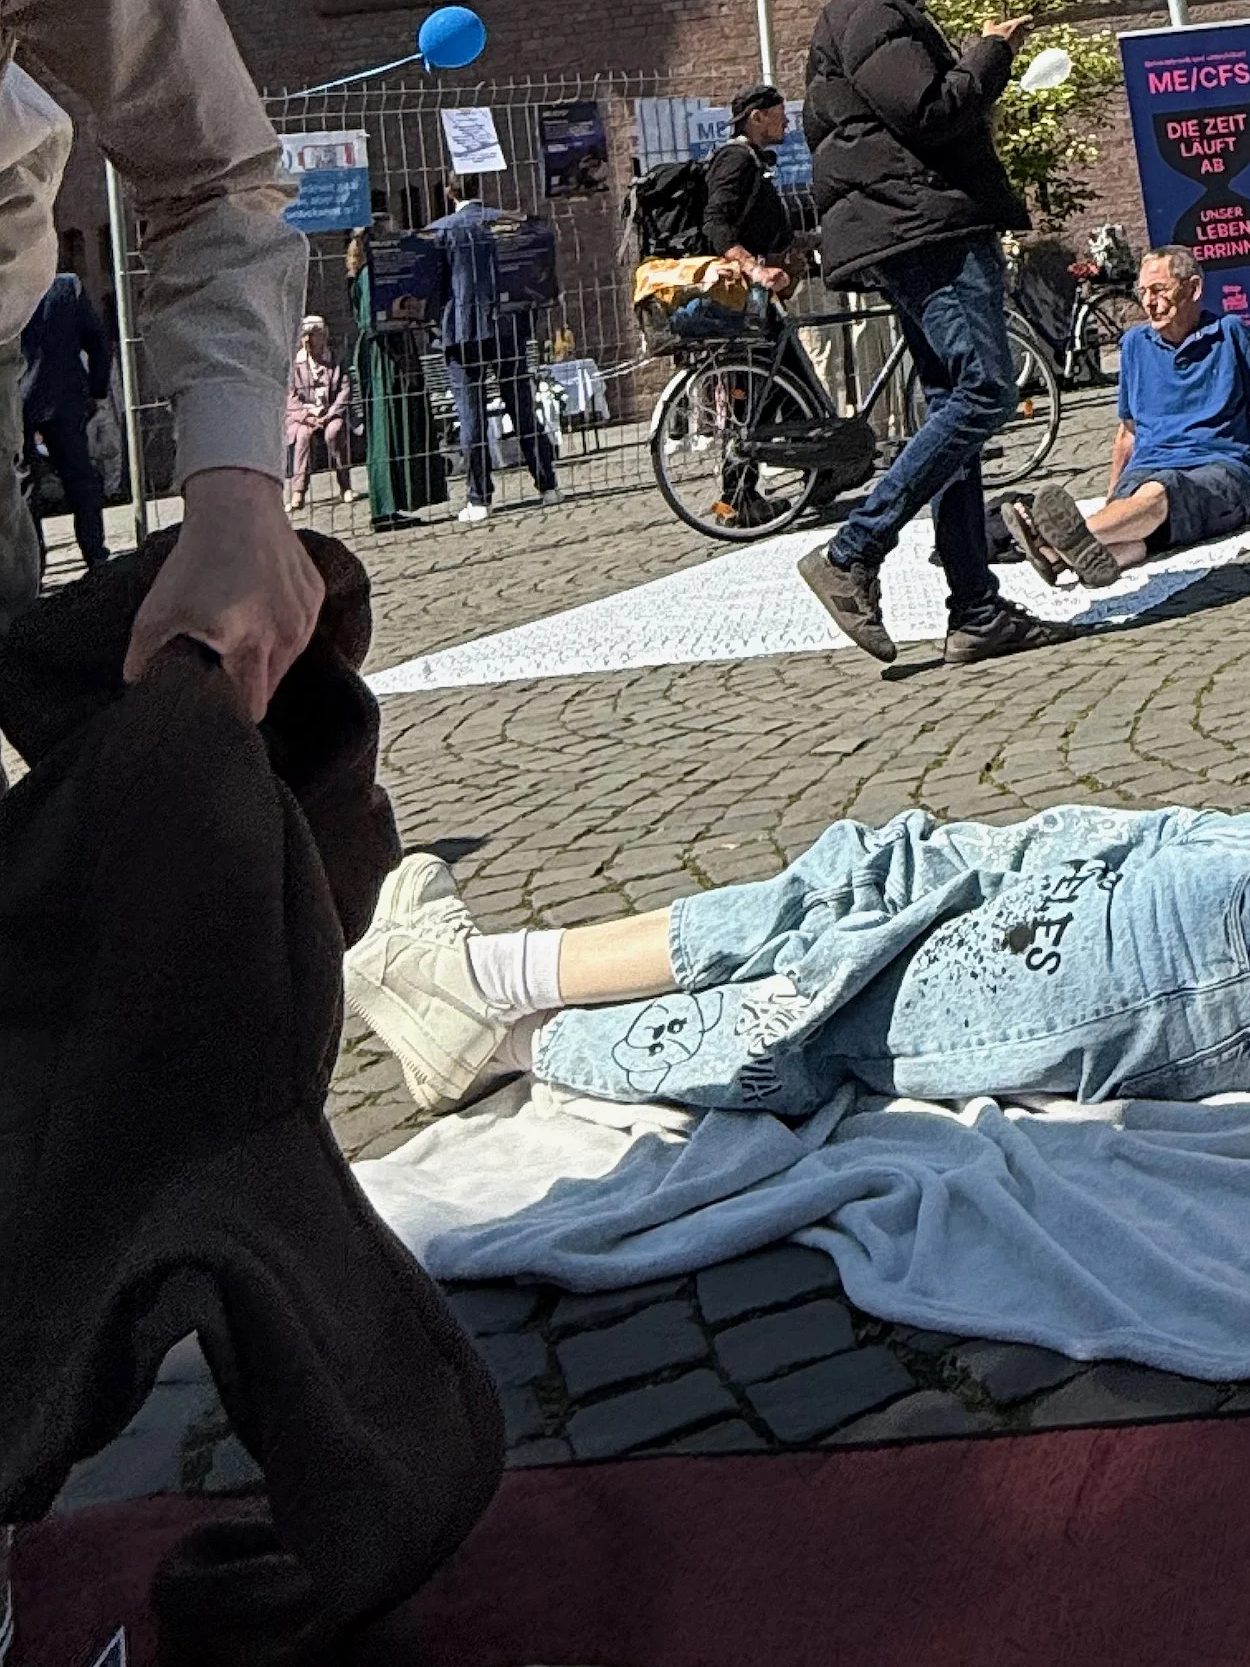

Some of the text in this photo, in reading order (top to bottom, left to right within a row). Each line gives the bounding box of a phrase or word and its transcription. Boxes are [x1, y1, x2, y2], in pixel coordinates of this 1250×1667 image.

[1166, 113, 1247, 139] DIE ZEIT
[1180, 136, 1237, 158] LÄUFT
[1200, 158, 1225, 175] AB
[1200, 206, 1243, 222] UNSER
